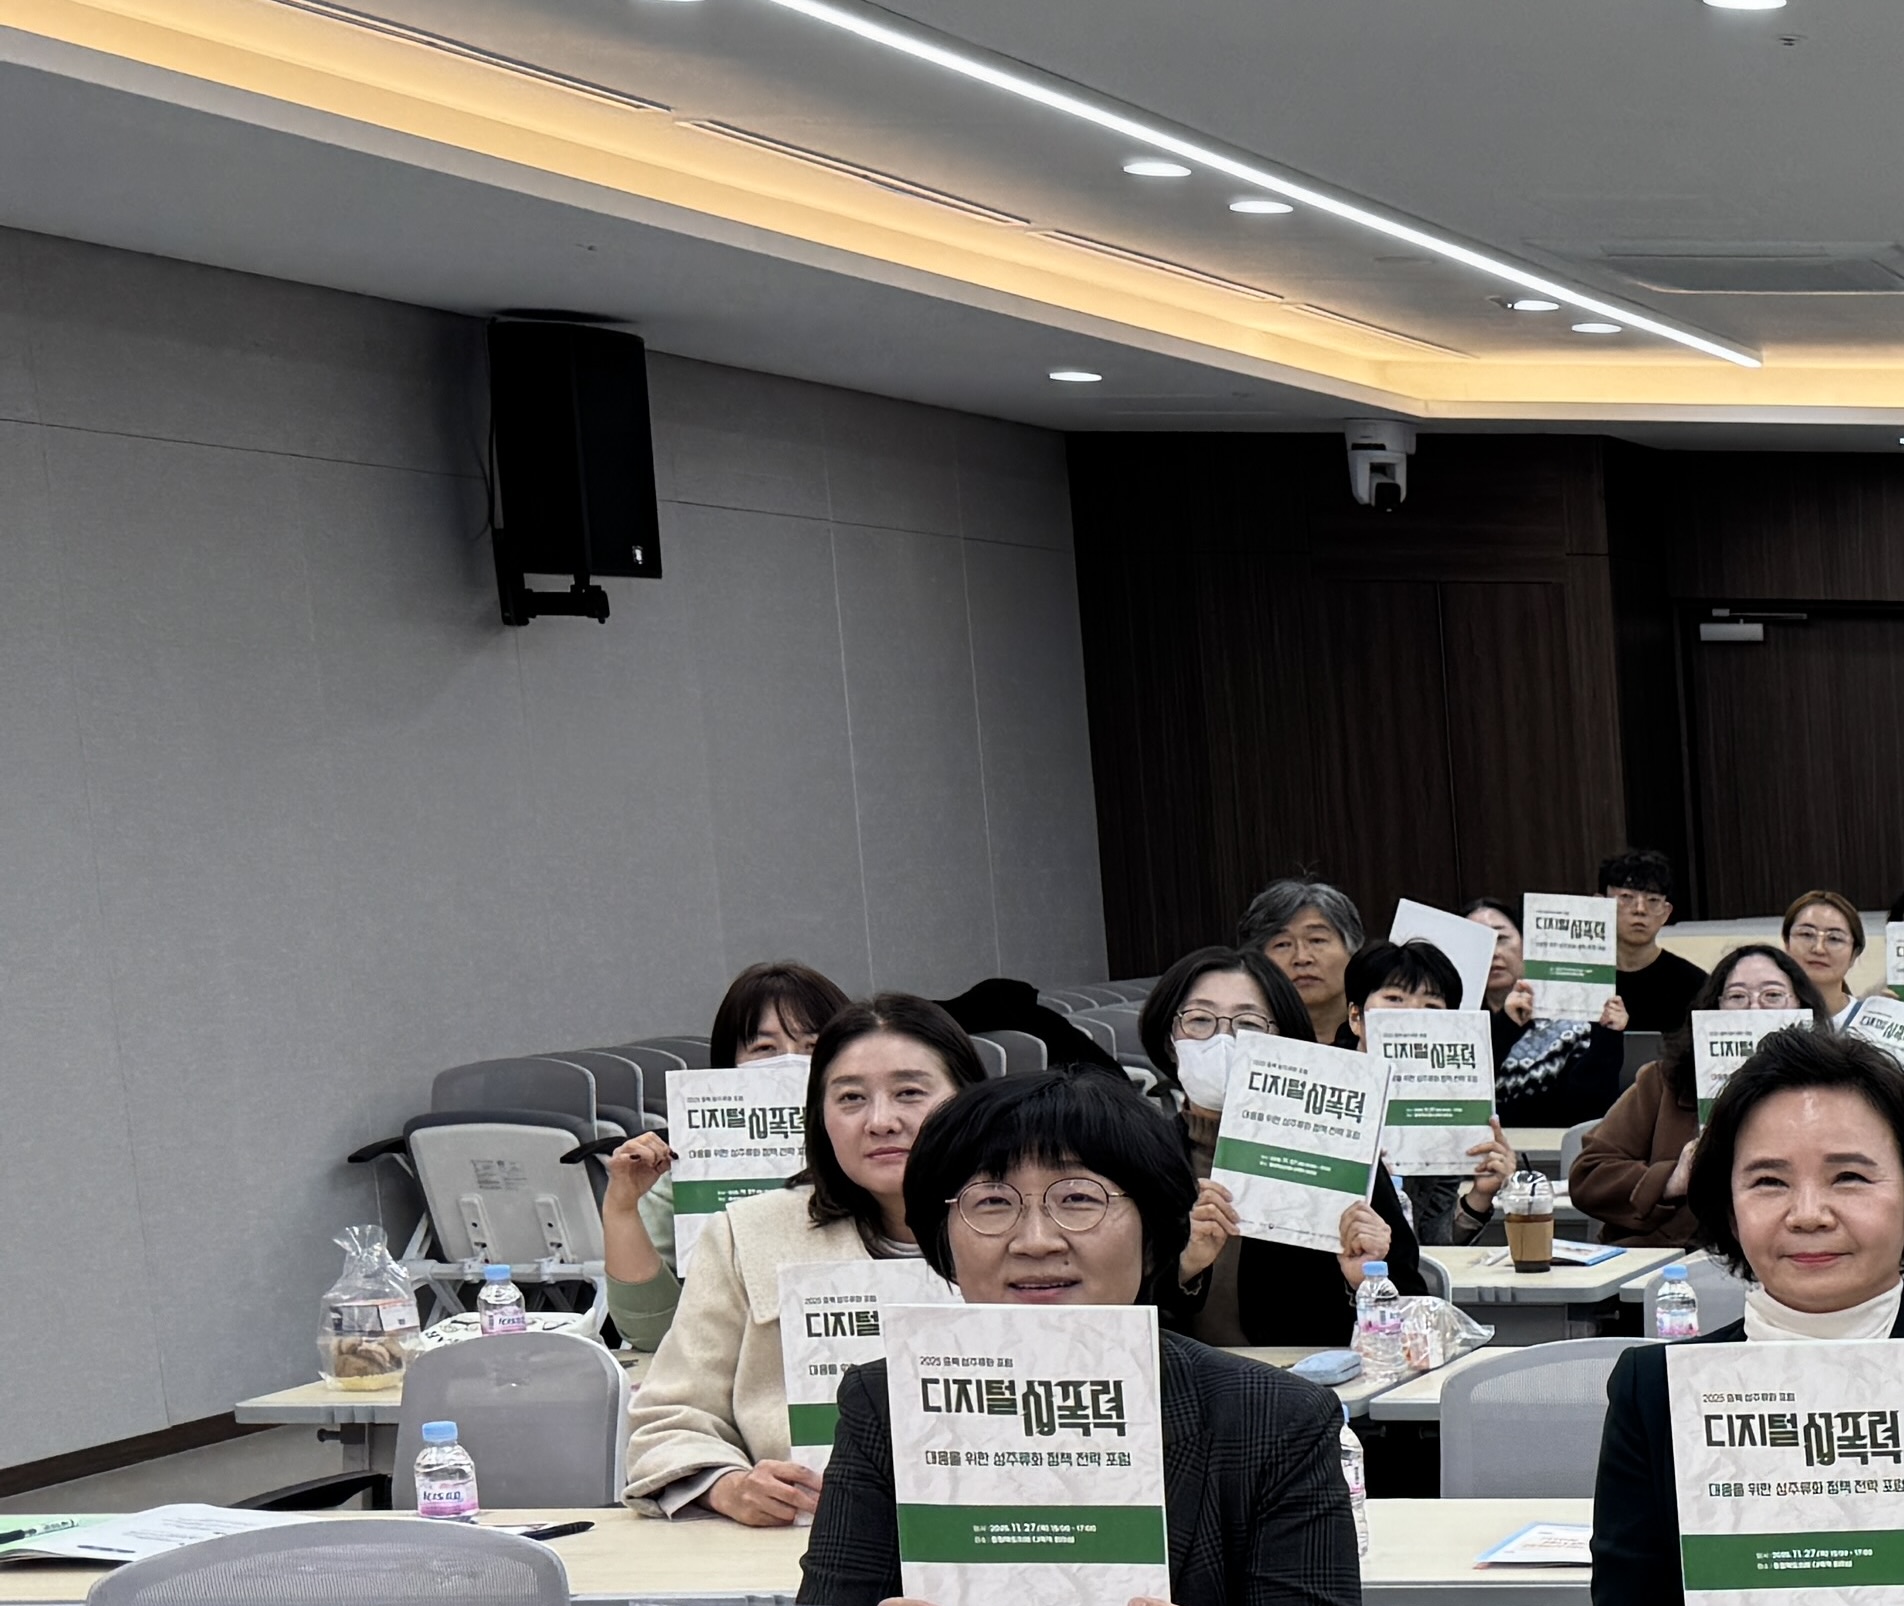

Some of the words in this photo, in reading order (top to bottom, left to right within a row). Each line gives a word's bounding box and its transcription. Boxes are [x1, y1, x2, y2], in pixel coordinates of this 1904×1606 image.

[1383, 1043, 1427, 1058] 디지털
[1431, 1043, 1475, 1068] 성폭력
[1247, 1071, 1306, 1099] 디지털
[1303, 1082, 1366, 1123] 성폭력
[687, 1108, 745, 1128] 디지털
[806, 1311, 880, 1337] 디지털
[921, 1378, 1017, 1415] 디지털
[1020, 1379, 1126, 1437] 성폭력
[1704, 1412, 1798, 1448] 디지털
[1803, 1410, 1902, 1466] 성폭력
[965, 1451, 988, 1466] 위한
[1106, 1452, 1130, 1466] 포럼
[1748, 1482, 1770, 1496] 위한
[1882, 1479, 1904, 1492] 포럼
